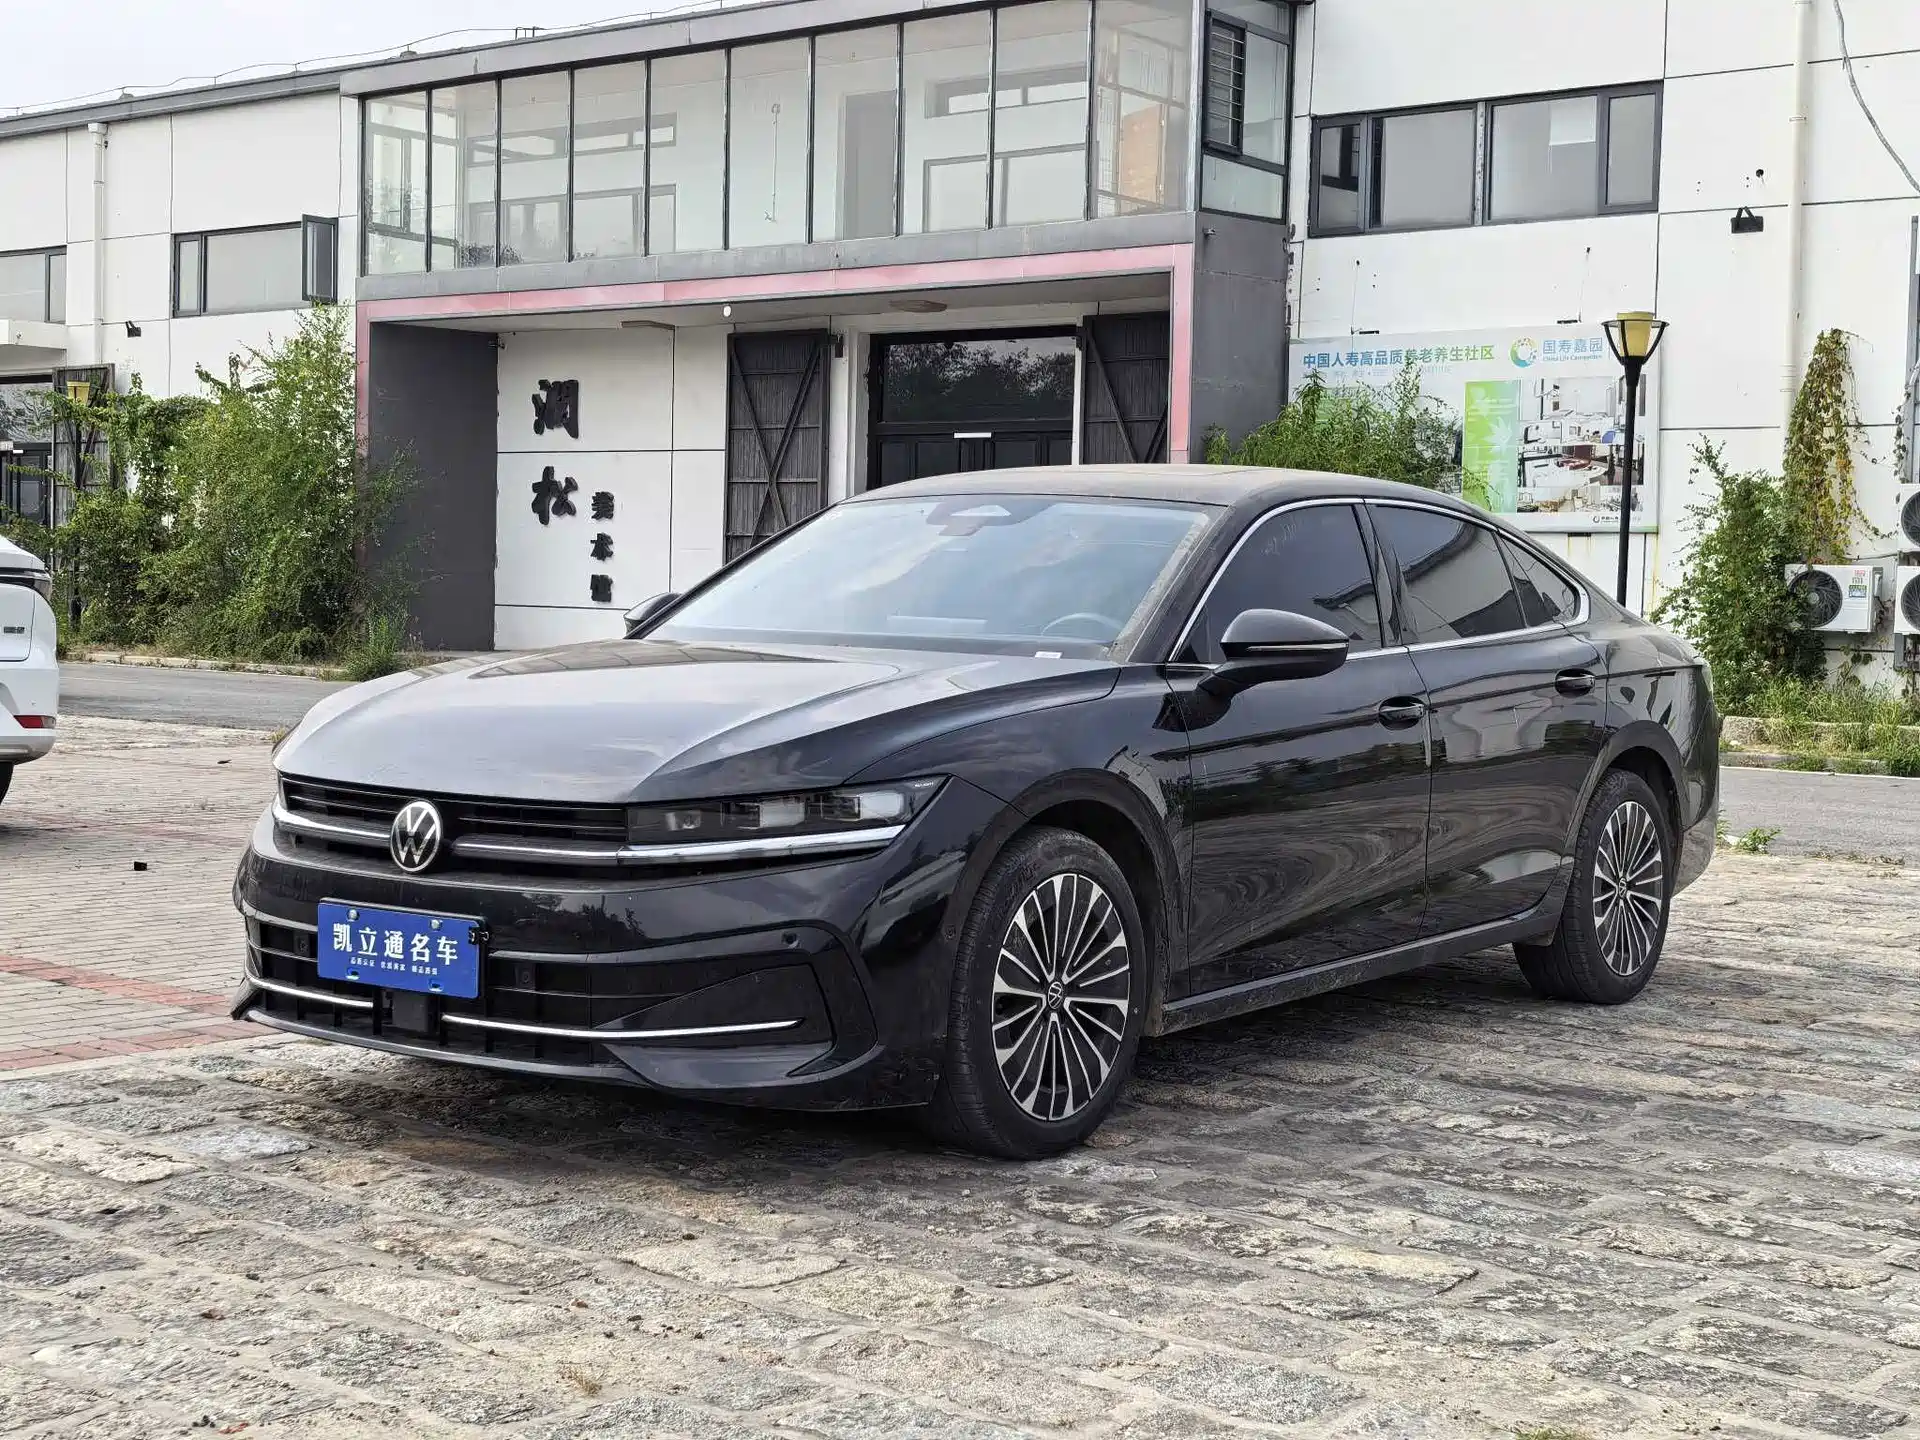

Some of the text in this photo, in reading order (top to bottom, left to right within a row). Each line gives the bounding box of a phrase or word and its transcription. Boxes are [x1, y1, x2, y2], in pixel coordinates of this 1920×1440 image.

[1303, 345, 1494, 368] 中国人寿高品质养老养生社区
[1543, 337, 1603, 354] 国寿嘉园
[332, 922, 458, 966] 凯立通名车
